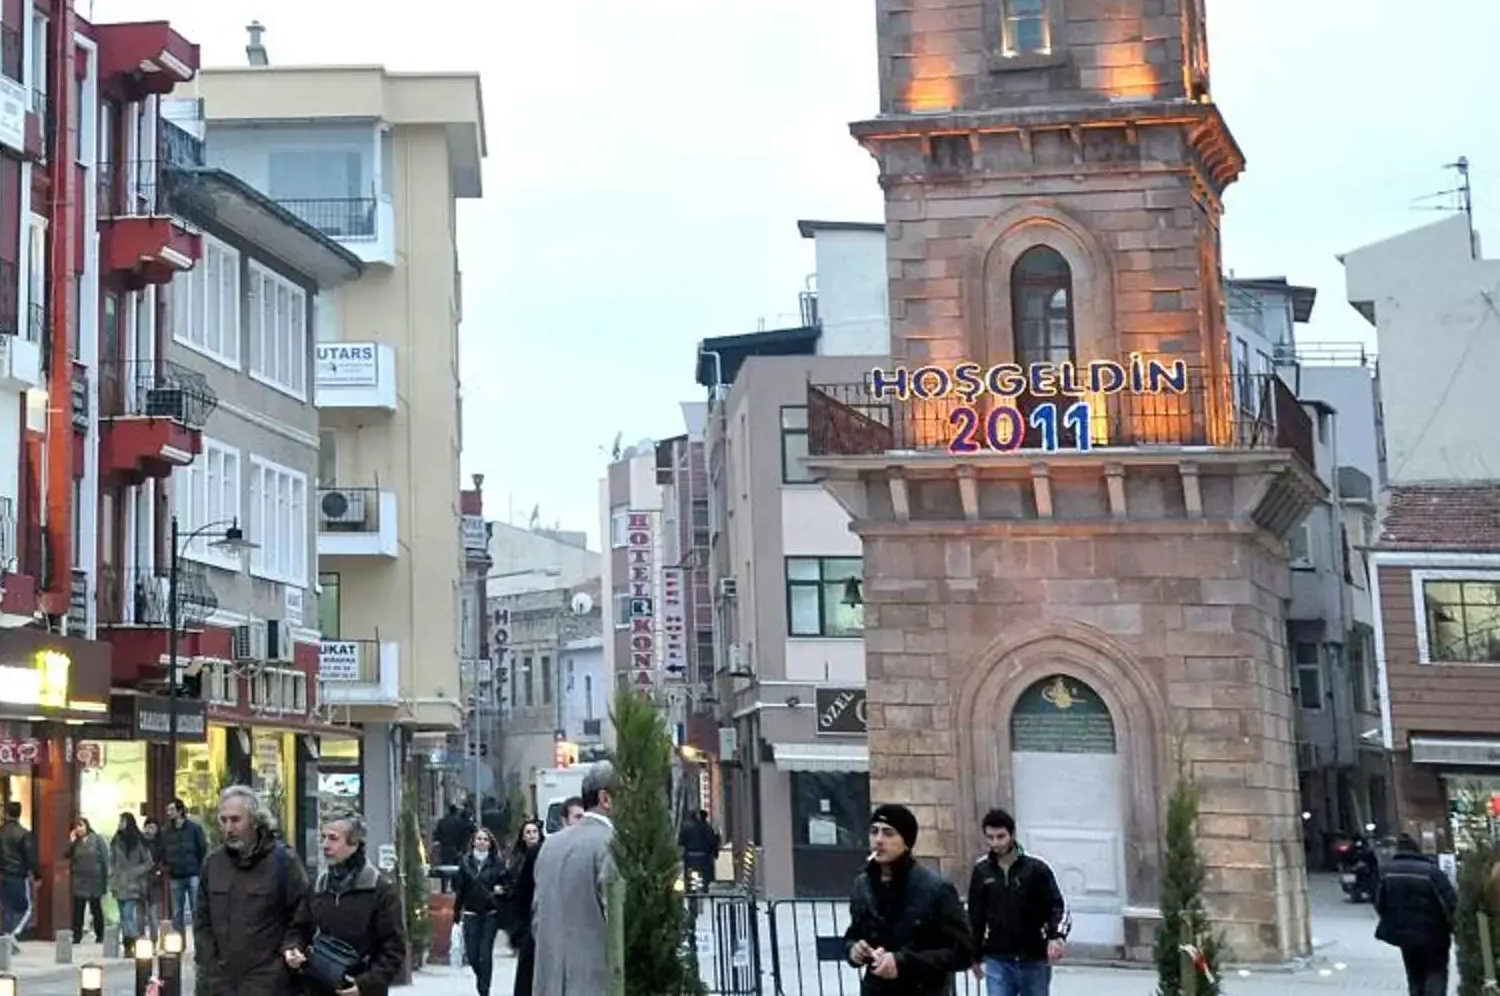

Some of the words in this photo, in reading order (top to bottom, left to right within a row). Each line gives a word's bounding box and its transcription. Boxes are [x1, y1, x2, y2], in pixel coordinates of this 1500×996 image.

[870, 351, 1189, 404] HOŞGELDİN
[949, 402, 1093, 454] 2011
[628, 514, 651, 597] HOTEL
